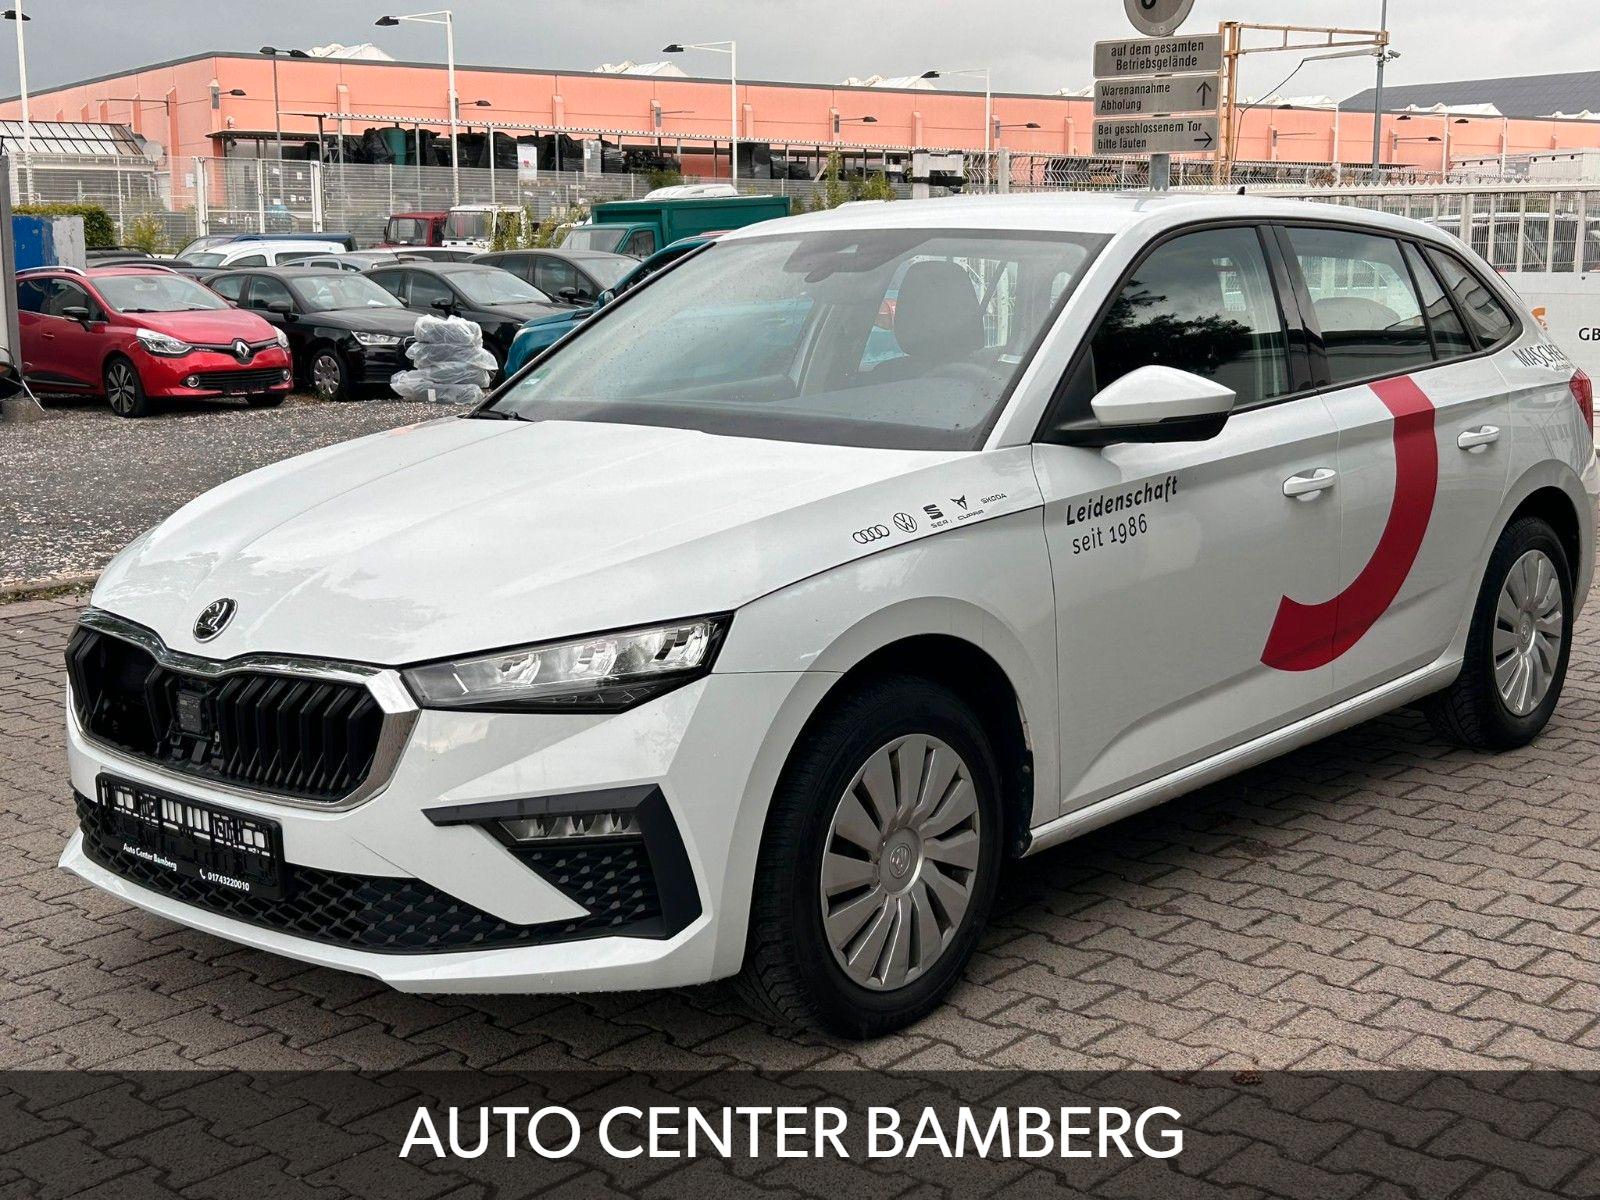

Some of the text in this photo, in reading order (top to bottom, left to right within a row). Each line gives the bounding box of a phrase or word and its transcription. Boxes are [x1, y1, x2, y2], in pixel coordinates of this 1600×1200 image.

[1111, 40, 1204, 56] auf dem gesamten
[1116, 55, 1197, 71] Betriebsgelände
[1101, 84, 1171, 96] Warenannahme
[1101, 100, 1142, 111] Abholung
[1098, 121, 1202, 136] Bei geschlossenem Tor
[1098, 137, 1147, 149] bitte läuten
[1066, 475, 1178, 526] Leidenschaft
[1072, 513, 1148, 555] seit 1986
[123, 842, 177, 871] Auto Center Bamberg
[207, 872, 250, 891] 01743220010
